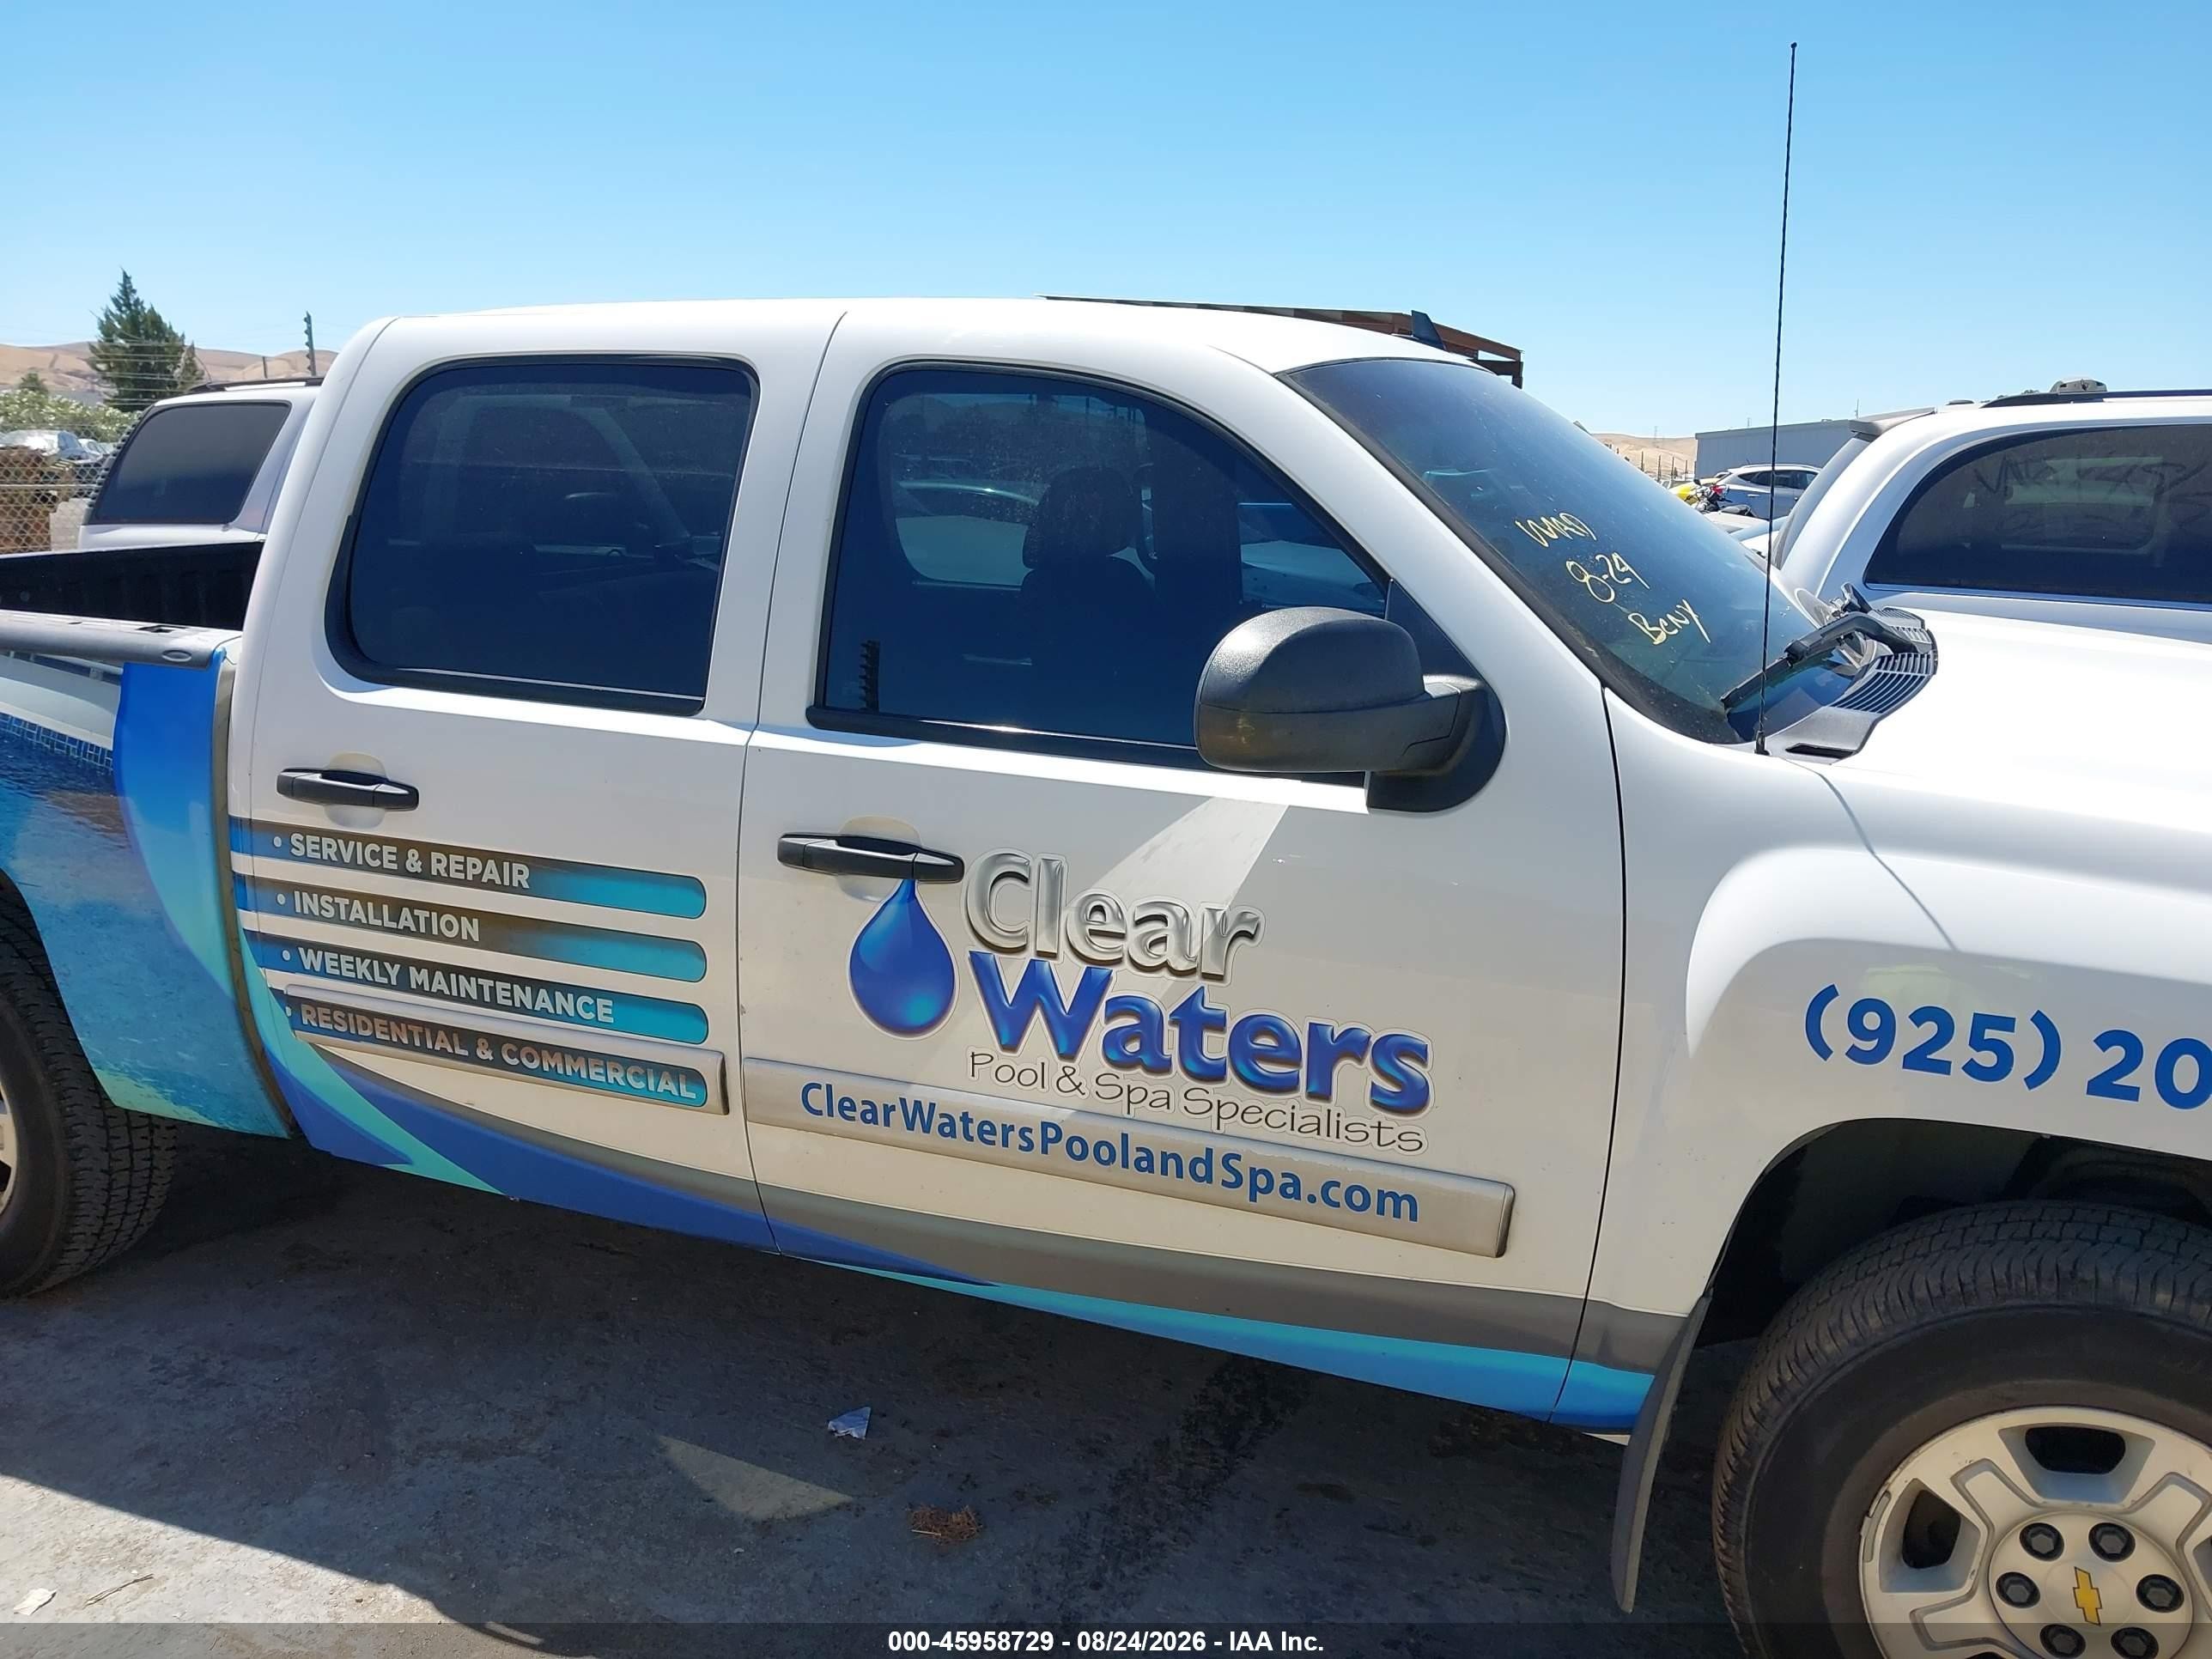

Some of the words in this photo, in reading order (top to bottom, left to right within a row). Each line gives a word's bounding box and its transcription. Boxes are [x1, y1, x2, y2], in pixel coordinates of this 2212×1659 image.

[290, 833, 397, 871] SERVICE
[405, 848, 423, 874] &
[430, 852, 531, 890] REPAIR
[293, 890, 480, 943] INSTALLATION
[966, 852, 1261, 980] Clear
[298, 946, 401, 987] WEEKLY
[409, 967, 615, 1024] MAINTENANCE
[969, 950, 1431, 1114] Waters
[301, 1004, 470, 1057] RESIDENTIAL
[475, 1036, 494, 1061] &
[501, 1042, 696, 1099] COMMERCIAL
[1805, 983, 2062, 1091] (925)
[2086, 1030, 2212, 1109] 20
[800, 1081, 1419, 1222] ClearWatersPoolandSpa.com
[969, 1051, 1046, 1090] Pool
[1056, 1065, 1086, 1096] &
[1095, 1073, 1172, 1115] Spa
[1183, 1086, 1424, 1152] Specialists
